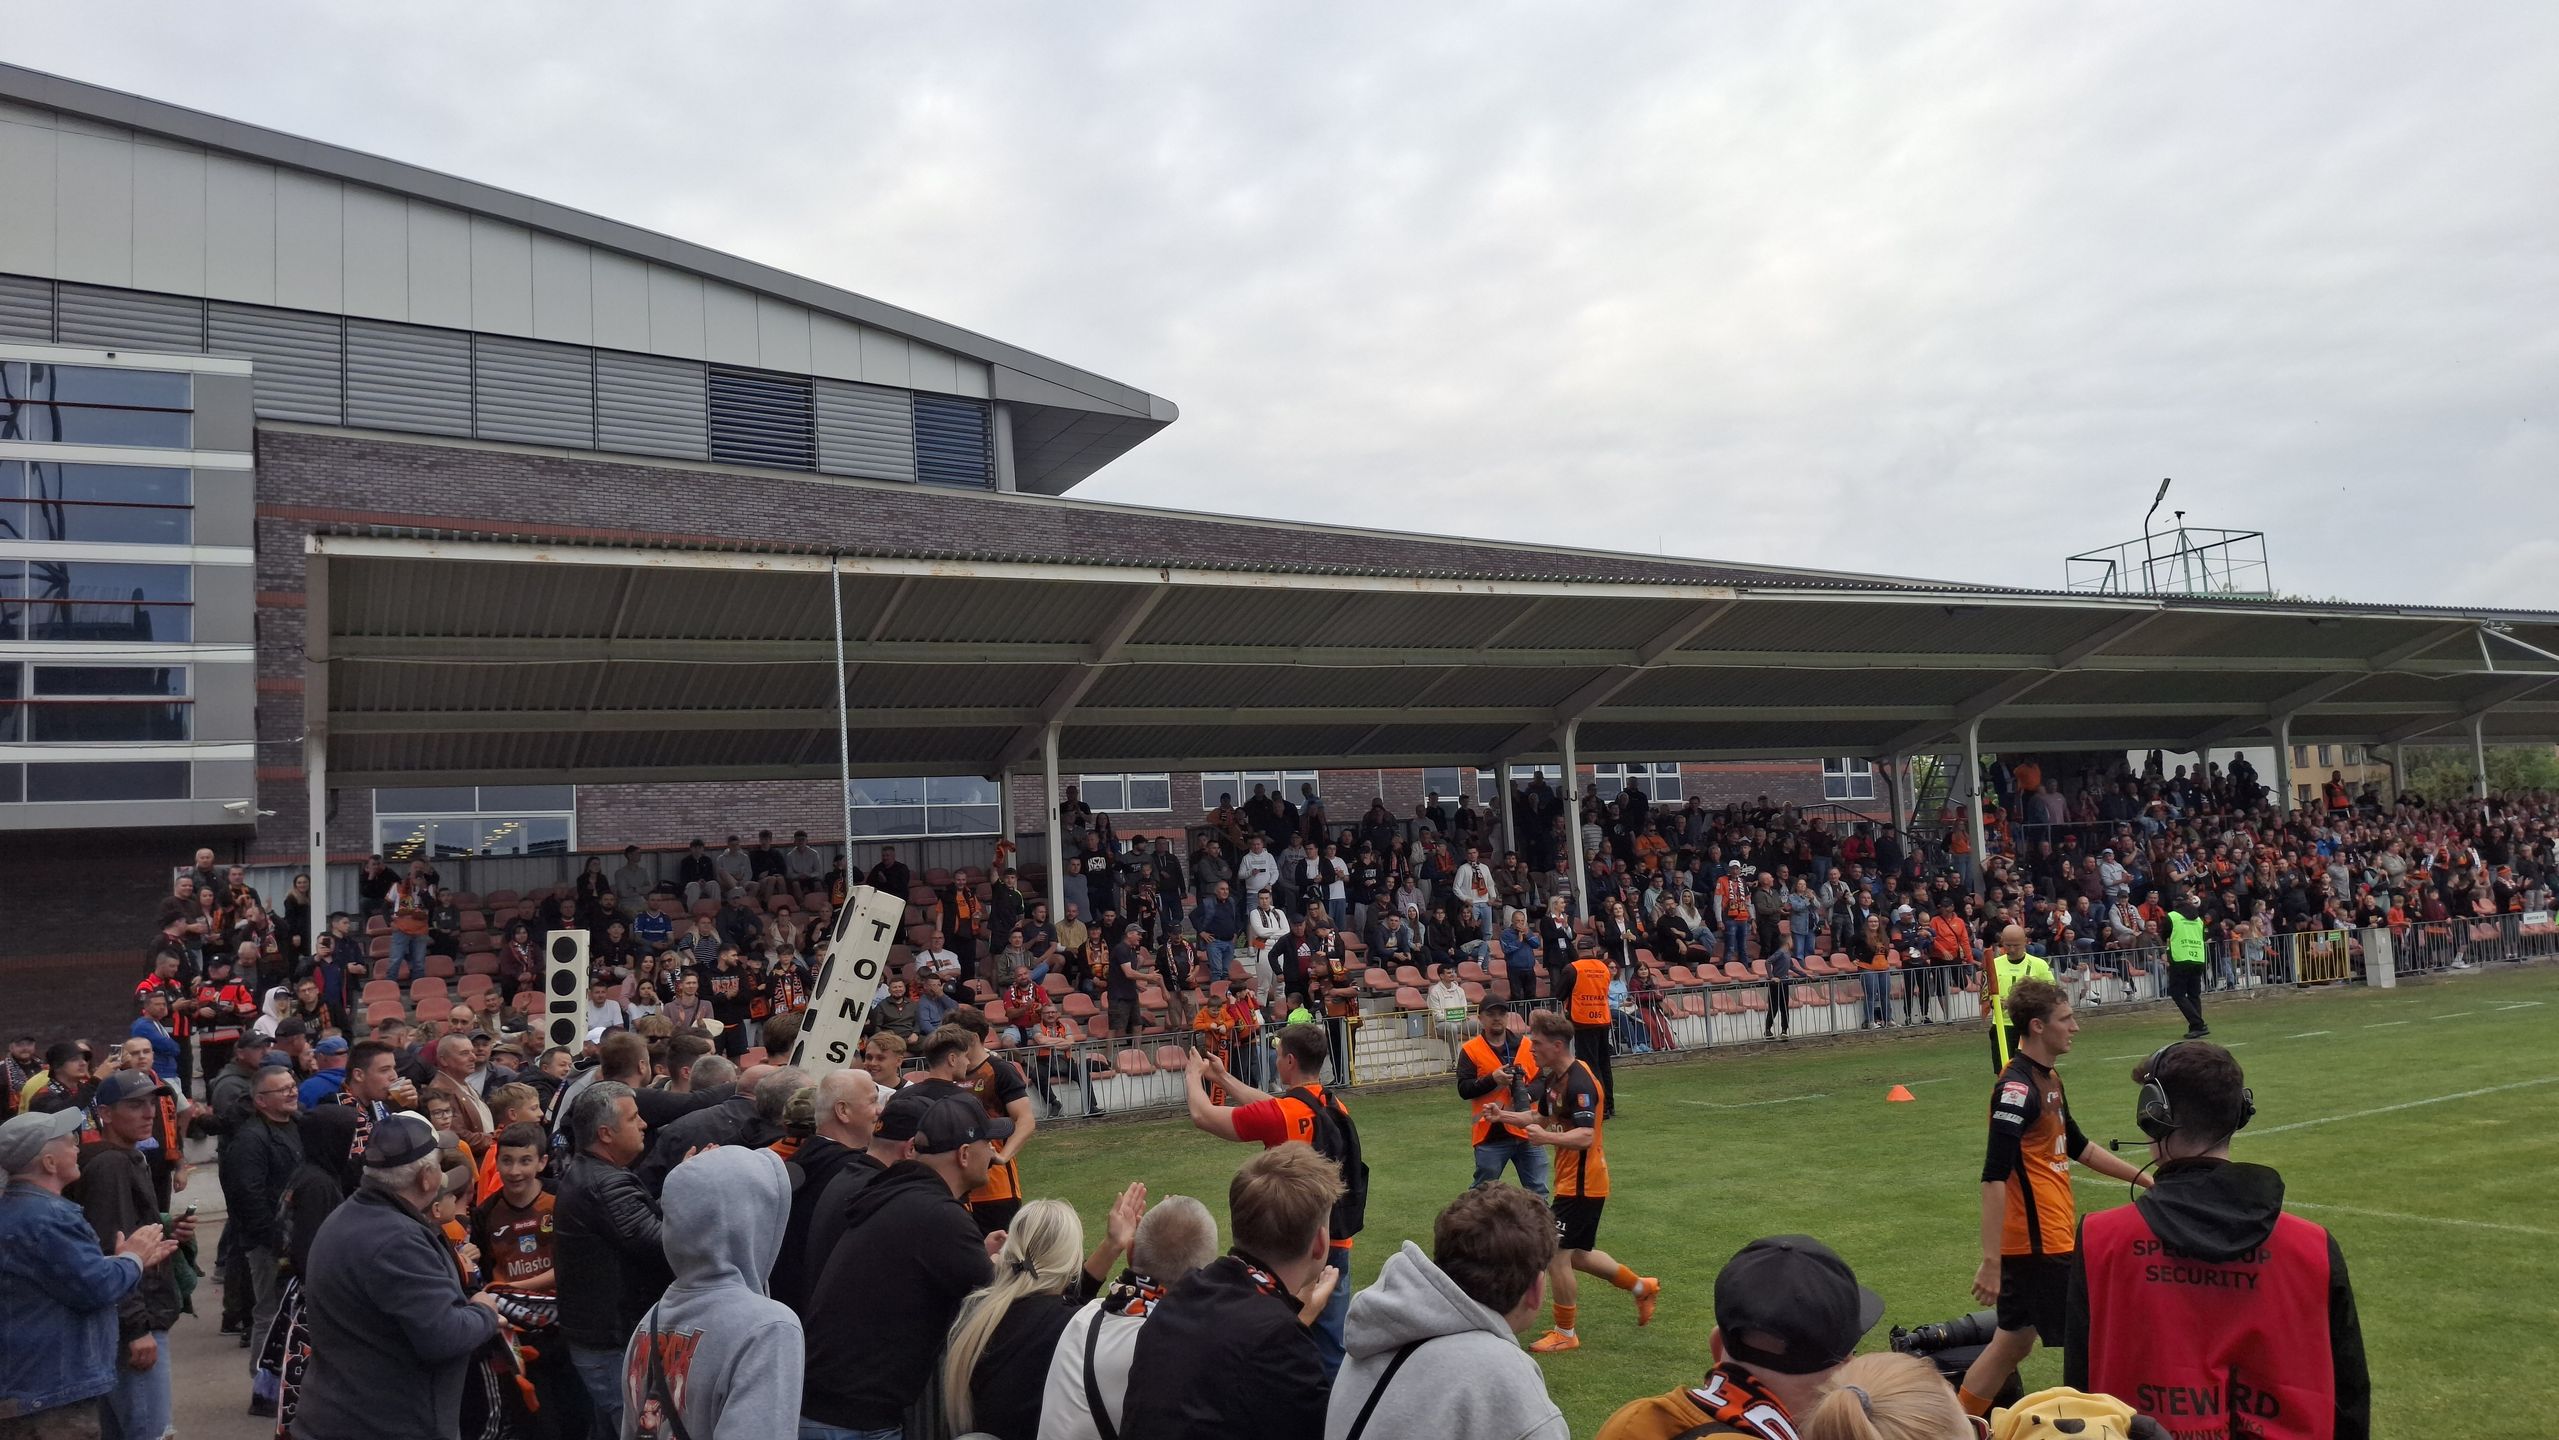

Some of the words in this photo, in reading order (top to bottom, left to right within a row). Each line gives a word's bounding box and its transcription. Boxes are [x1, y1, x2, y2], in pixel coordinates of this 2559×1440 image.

[826, 919, 891, 1064] TONS
[508, 1256, 551, 1277] Miasto
[2145, 1265, 2259, 1289] SECURITY
[2136, 1383, 2281, 1420] STEWRD
